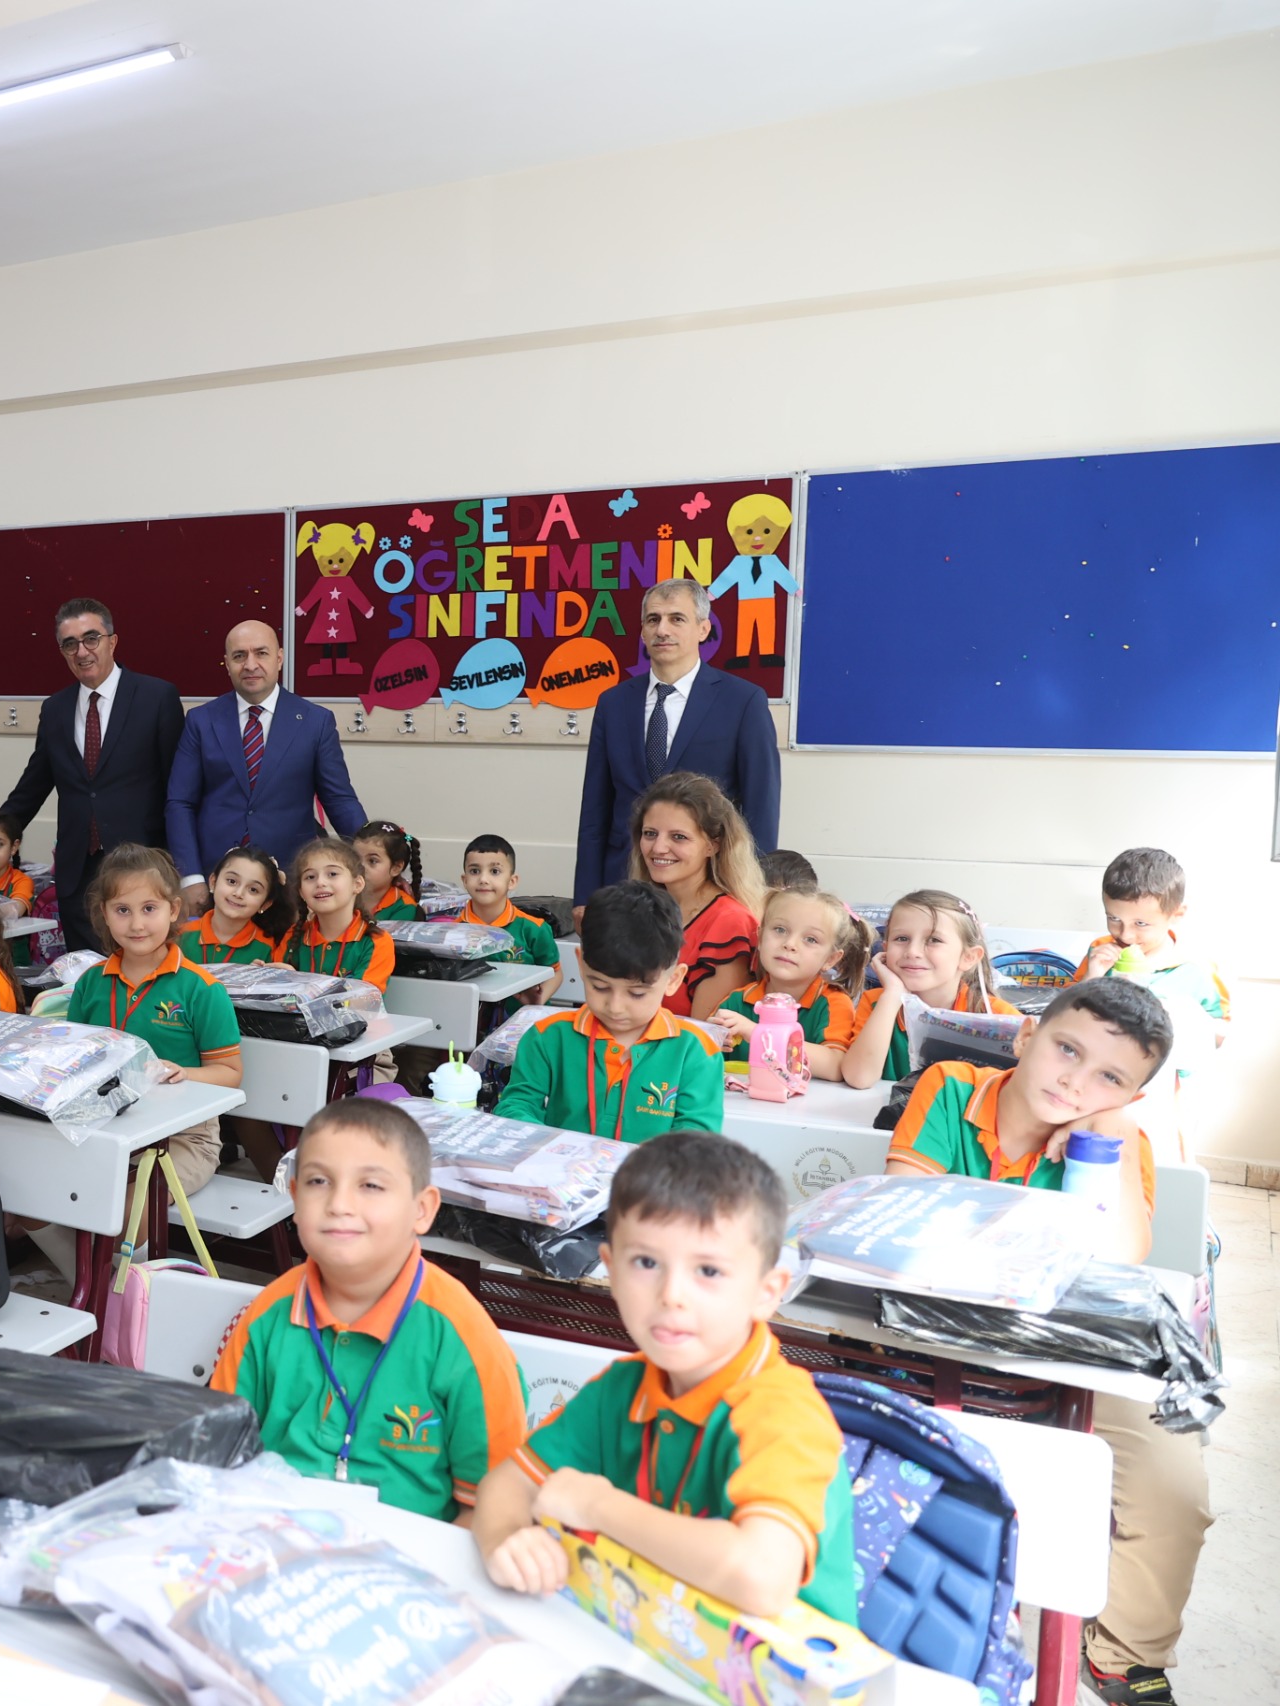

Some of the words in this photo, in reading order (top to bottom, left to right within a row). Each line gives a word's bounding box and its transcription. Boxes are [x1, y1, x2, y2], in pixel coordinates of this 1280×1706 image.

[454, 493, 580, 547] SEDA
[373, 522, 713, 594] ÖĞRETMENİN
[388, 590, 627, 639] SINIFINDA
[532, 1376, 559, 1389] EĞİTİM
